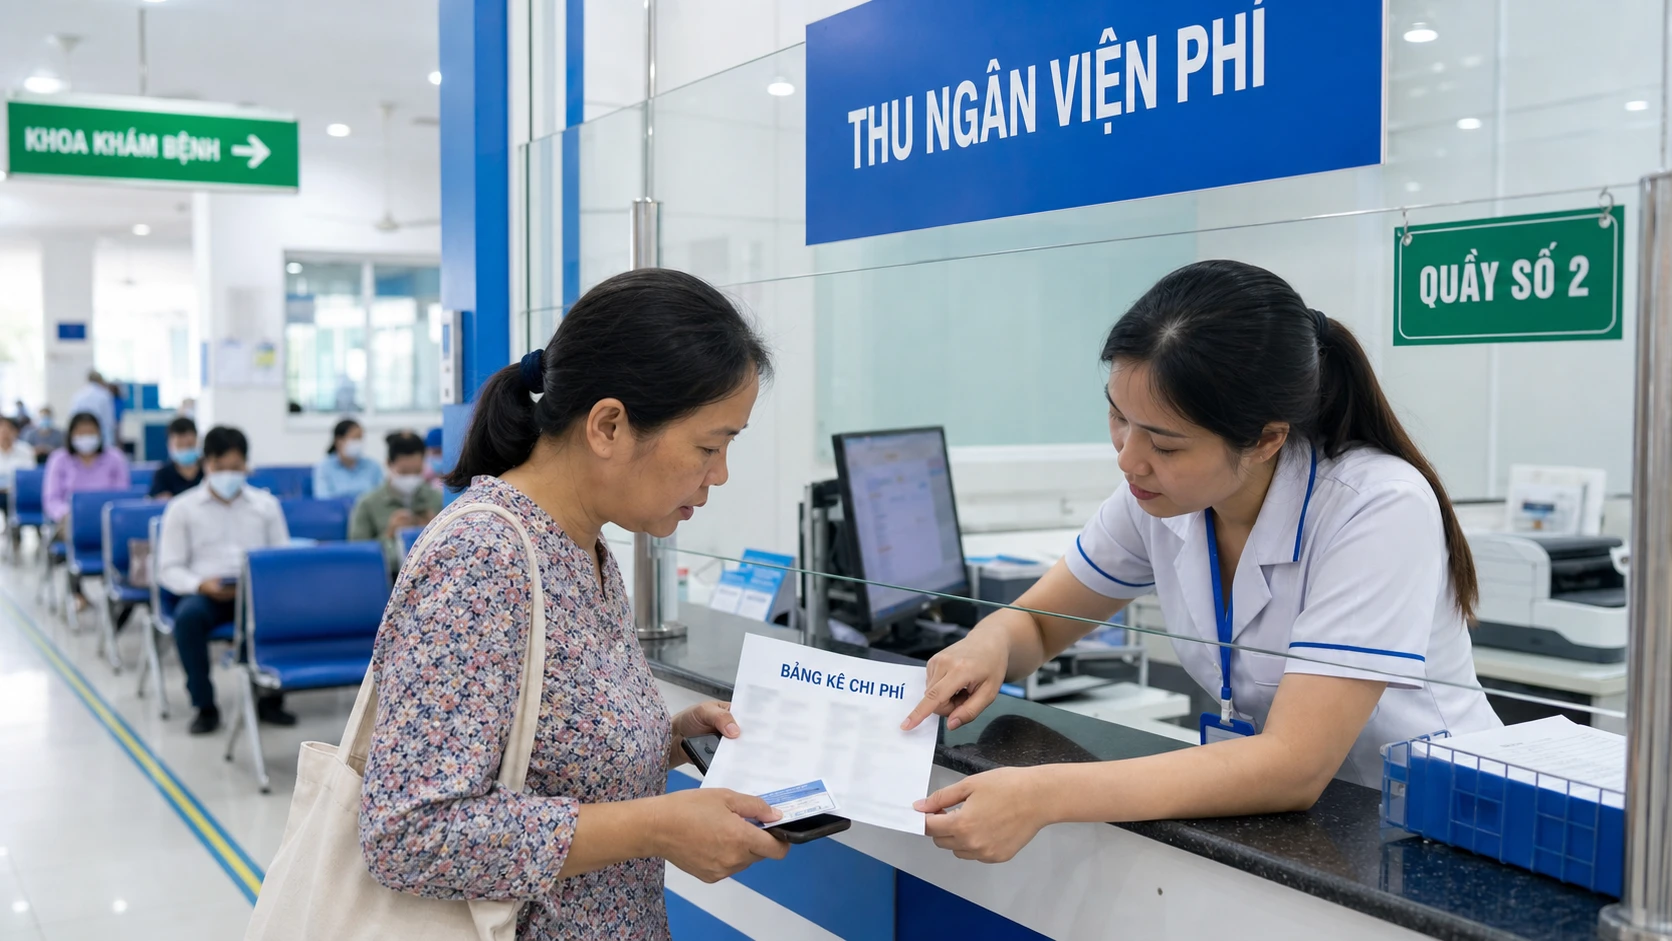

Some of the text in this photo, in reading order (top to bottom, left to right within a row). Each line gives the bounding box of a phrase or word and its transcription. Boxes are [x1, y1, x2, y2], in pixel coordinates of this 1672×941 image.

[847, 0, 1265, 170] THU NGÂN VIỆN PHÍ
[25, 126, 221, 165] KHOA KHÁM BỆNH
[1419, 241, 1590, 309] QUẦY SỐ 2
[780, 661, 906, 700] BẢNG KÊ CHI PHÍ
